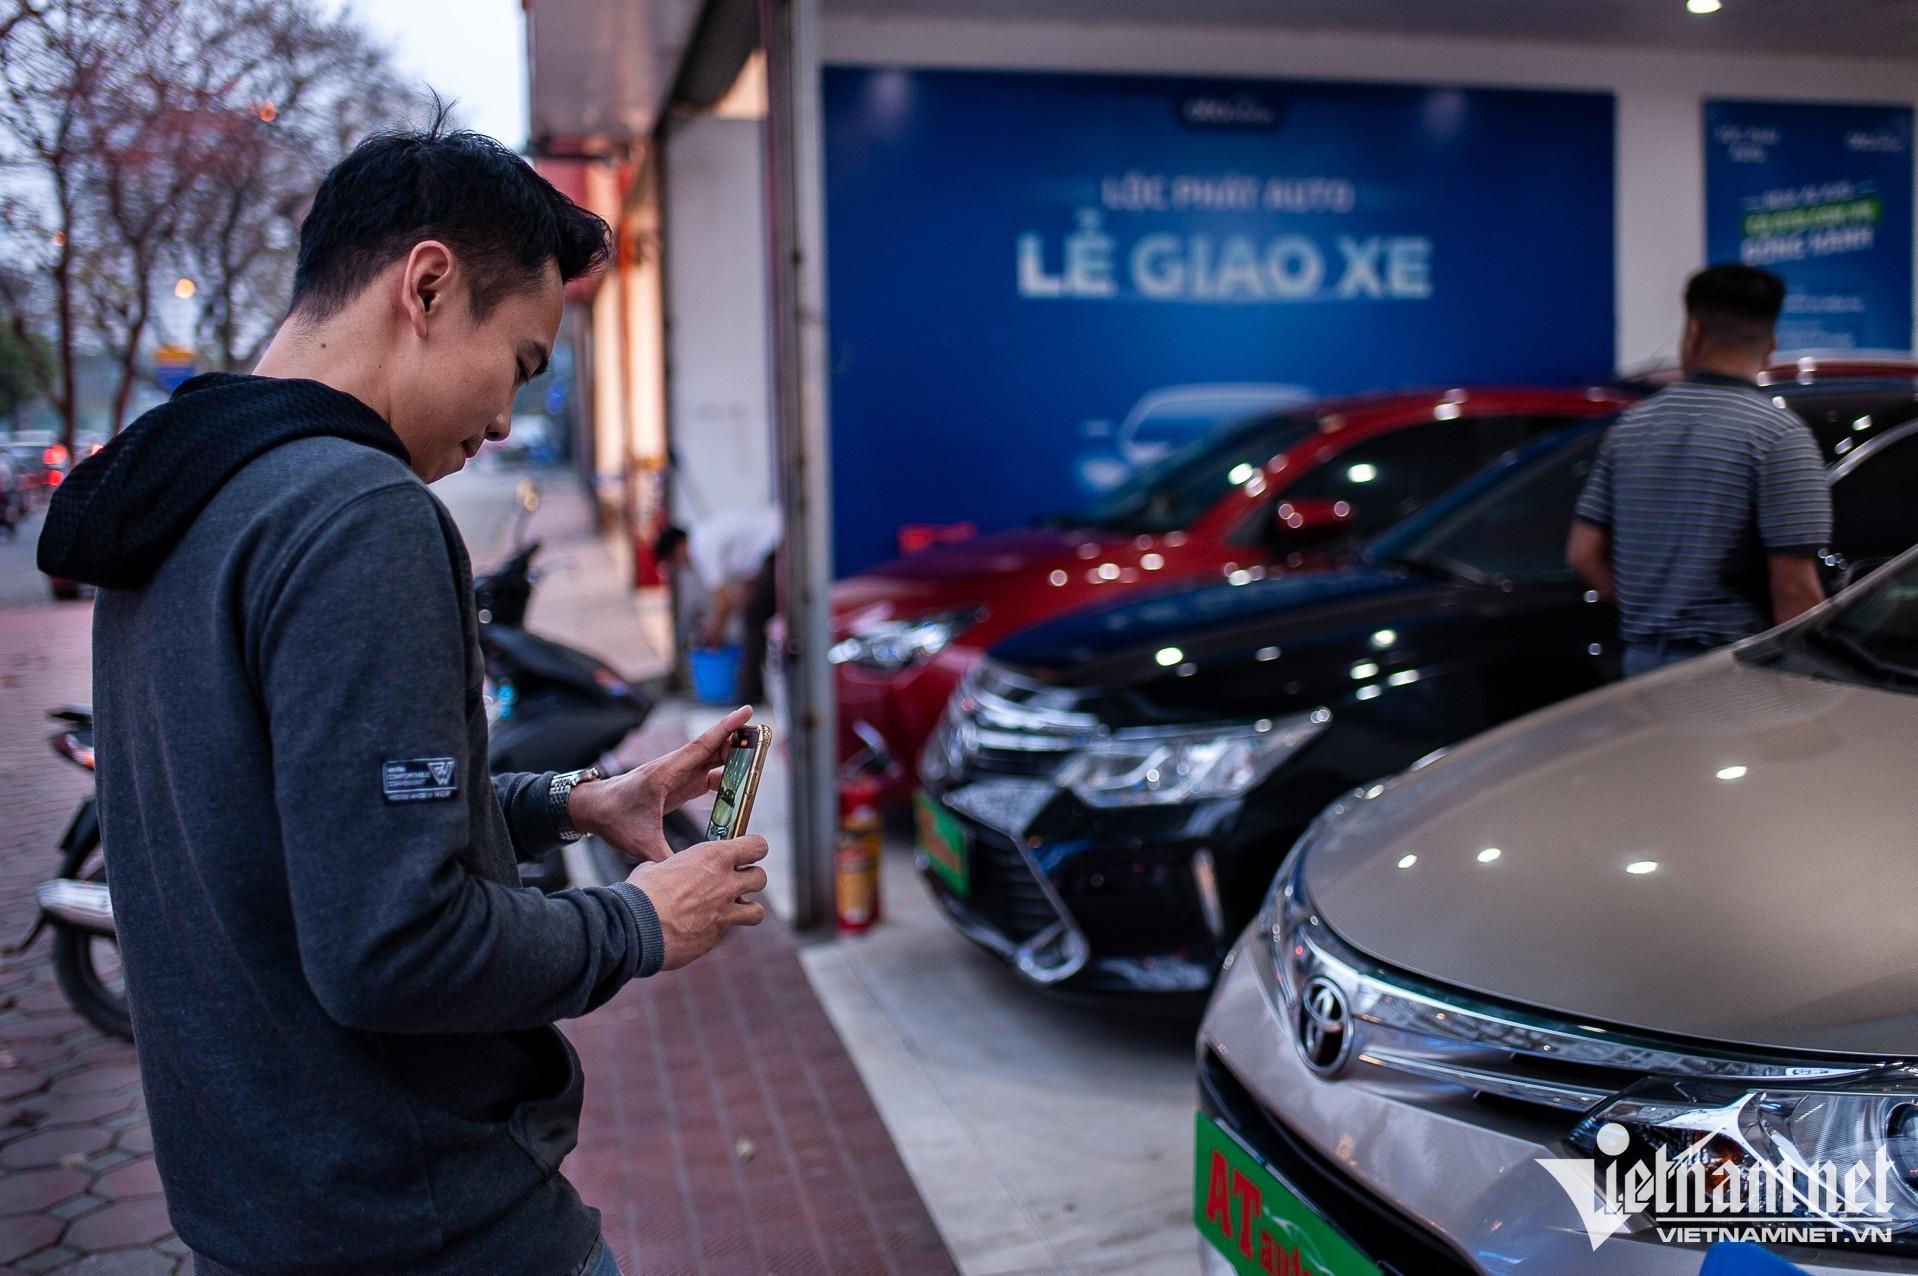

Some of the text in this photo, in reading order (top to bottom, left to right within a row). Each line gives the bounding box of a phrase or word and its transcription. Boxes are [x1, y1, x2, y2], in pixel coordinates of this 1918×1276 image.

[1262, 176, 1356, 213] AUTO
[1130, 233, 1326, 298] GIAO
[1337, 234, 1433, 298] XE
[1206, 1149, 1262, 1261] AT
[1260, 1228, 1313, 1276] aut
